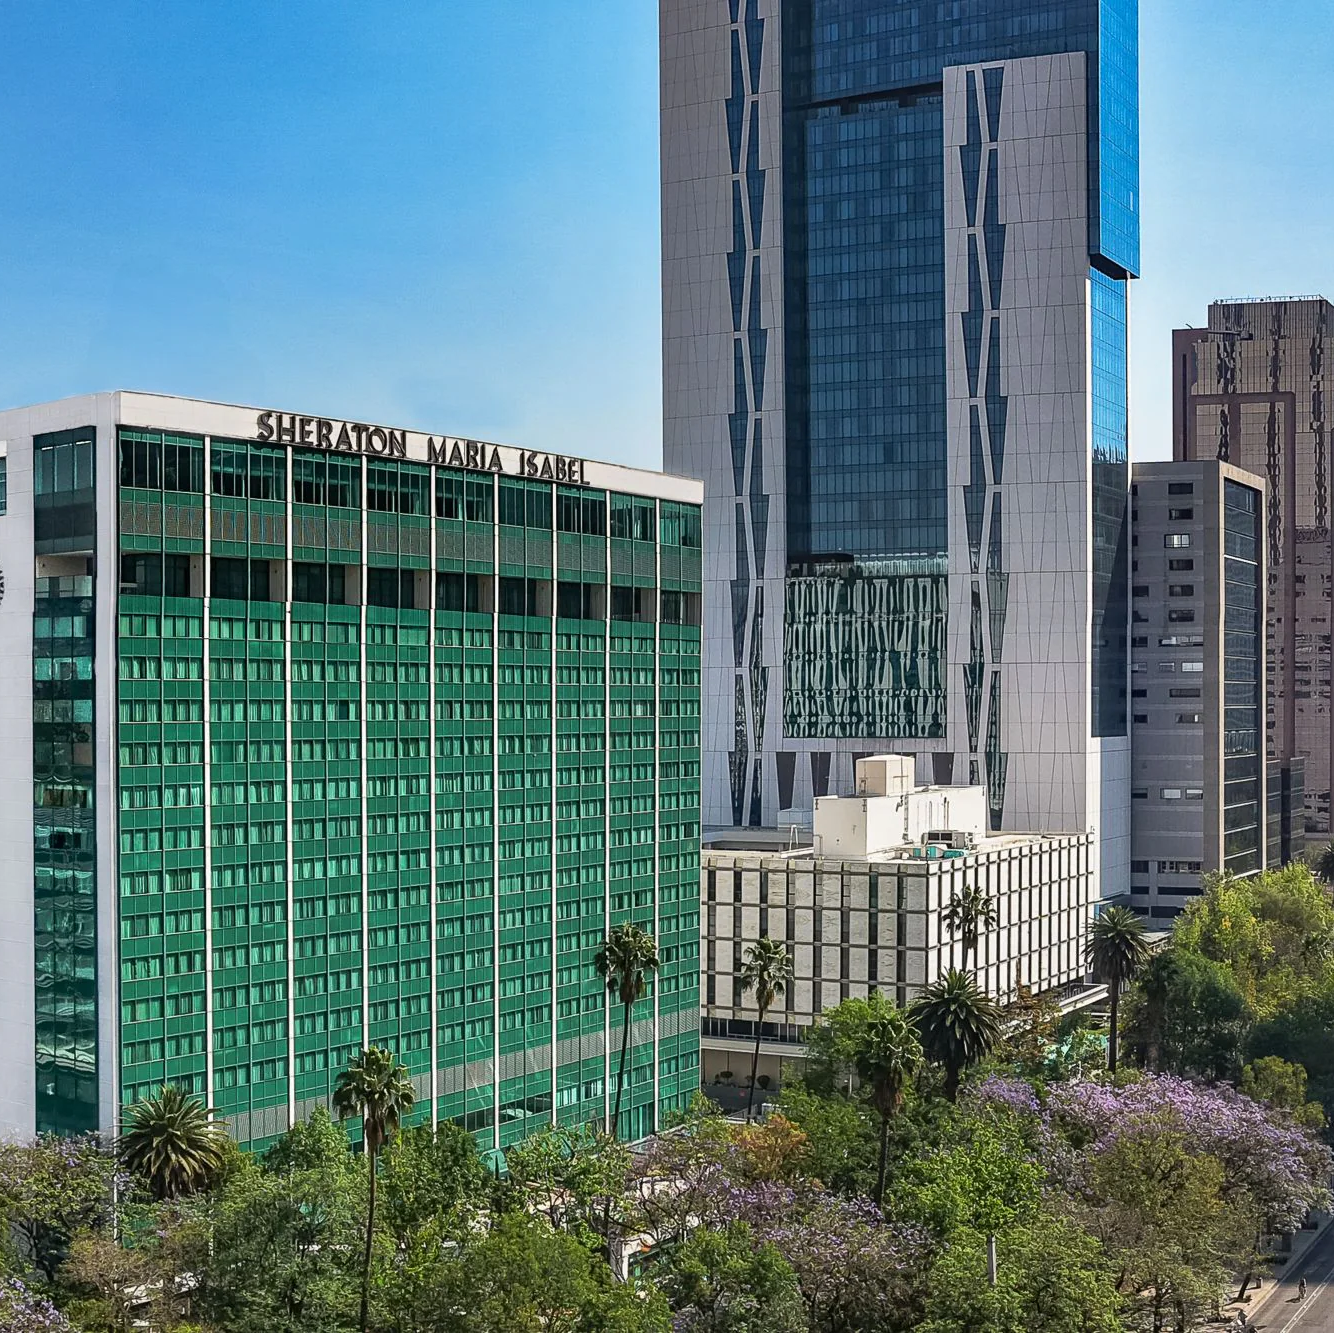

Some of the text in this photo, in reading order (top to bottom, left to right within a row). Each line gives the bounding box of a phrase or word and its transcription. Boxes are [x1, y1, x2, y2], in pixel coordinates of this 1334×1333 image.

[256, 411, 590, 485] SHERATON MARIA ISABEL
